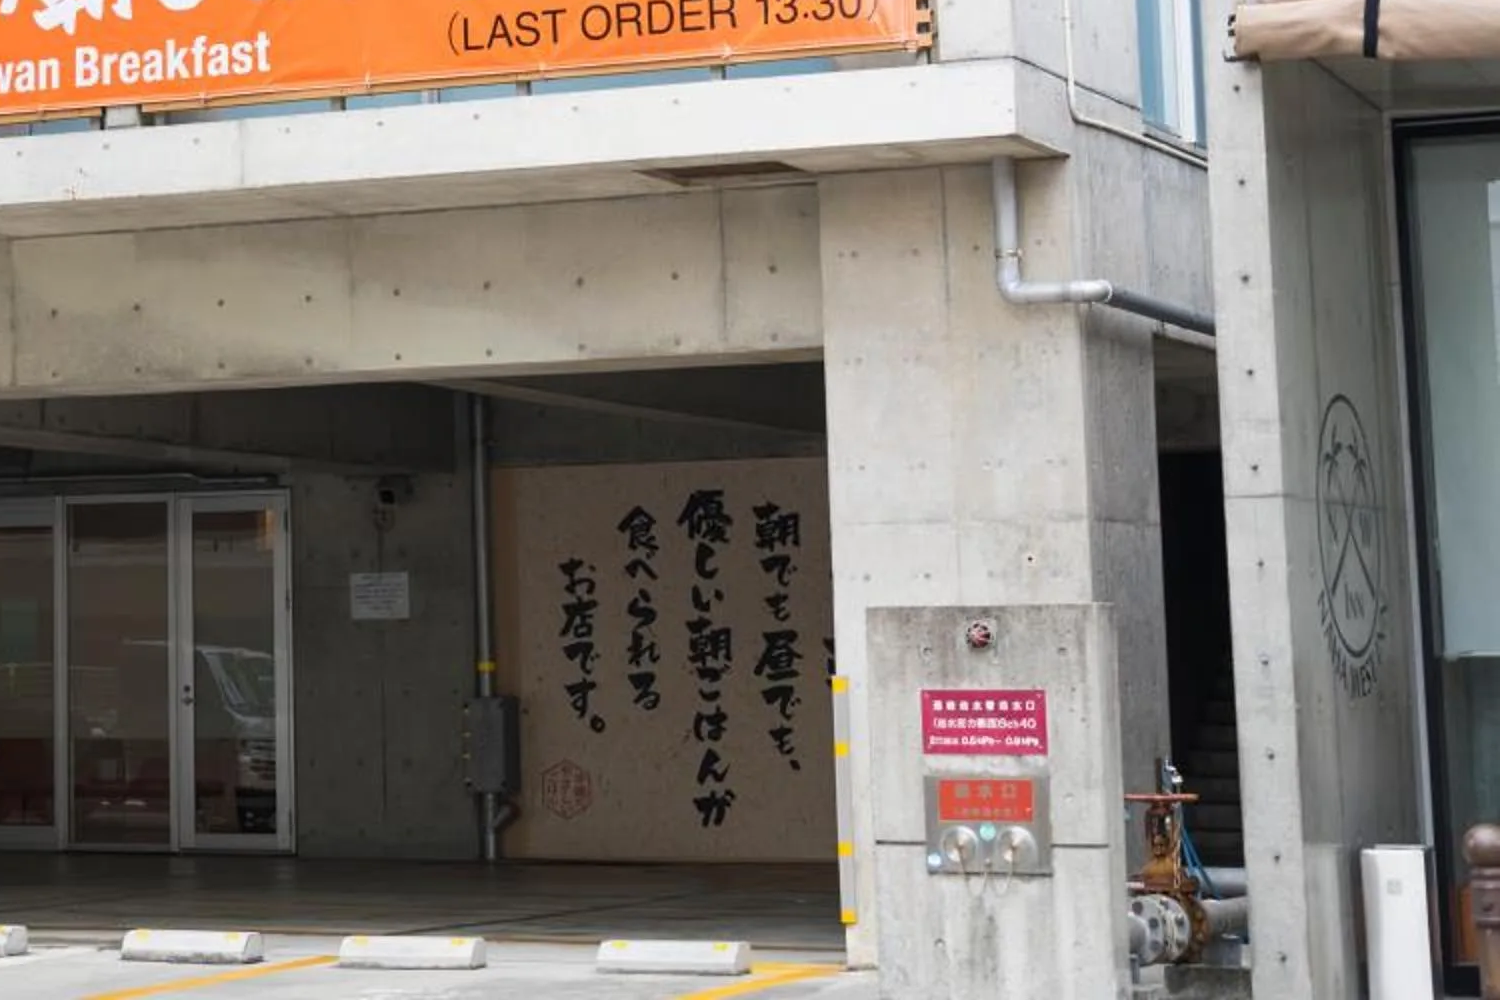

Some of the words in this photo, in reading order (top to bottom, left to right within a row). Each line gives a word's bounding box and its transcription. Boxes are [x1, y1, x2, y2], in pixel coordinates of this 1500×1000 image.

[74, 31, 271, 90] Breakfast
[447, 9, 567, 56] (LAST
[616, 505, 662, 712] 食べられる
[676, 488, 737, 828] 優しい朝ごはんが
